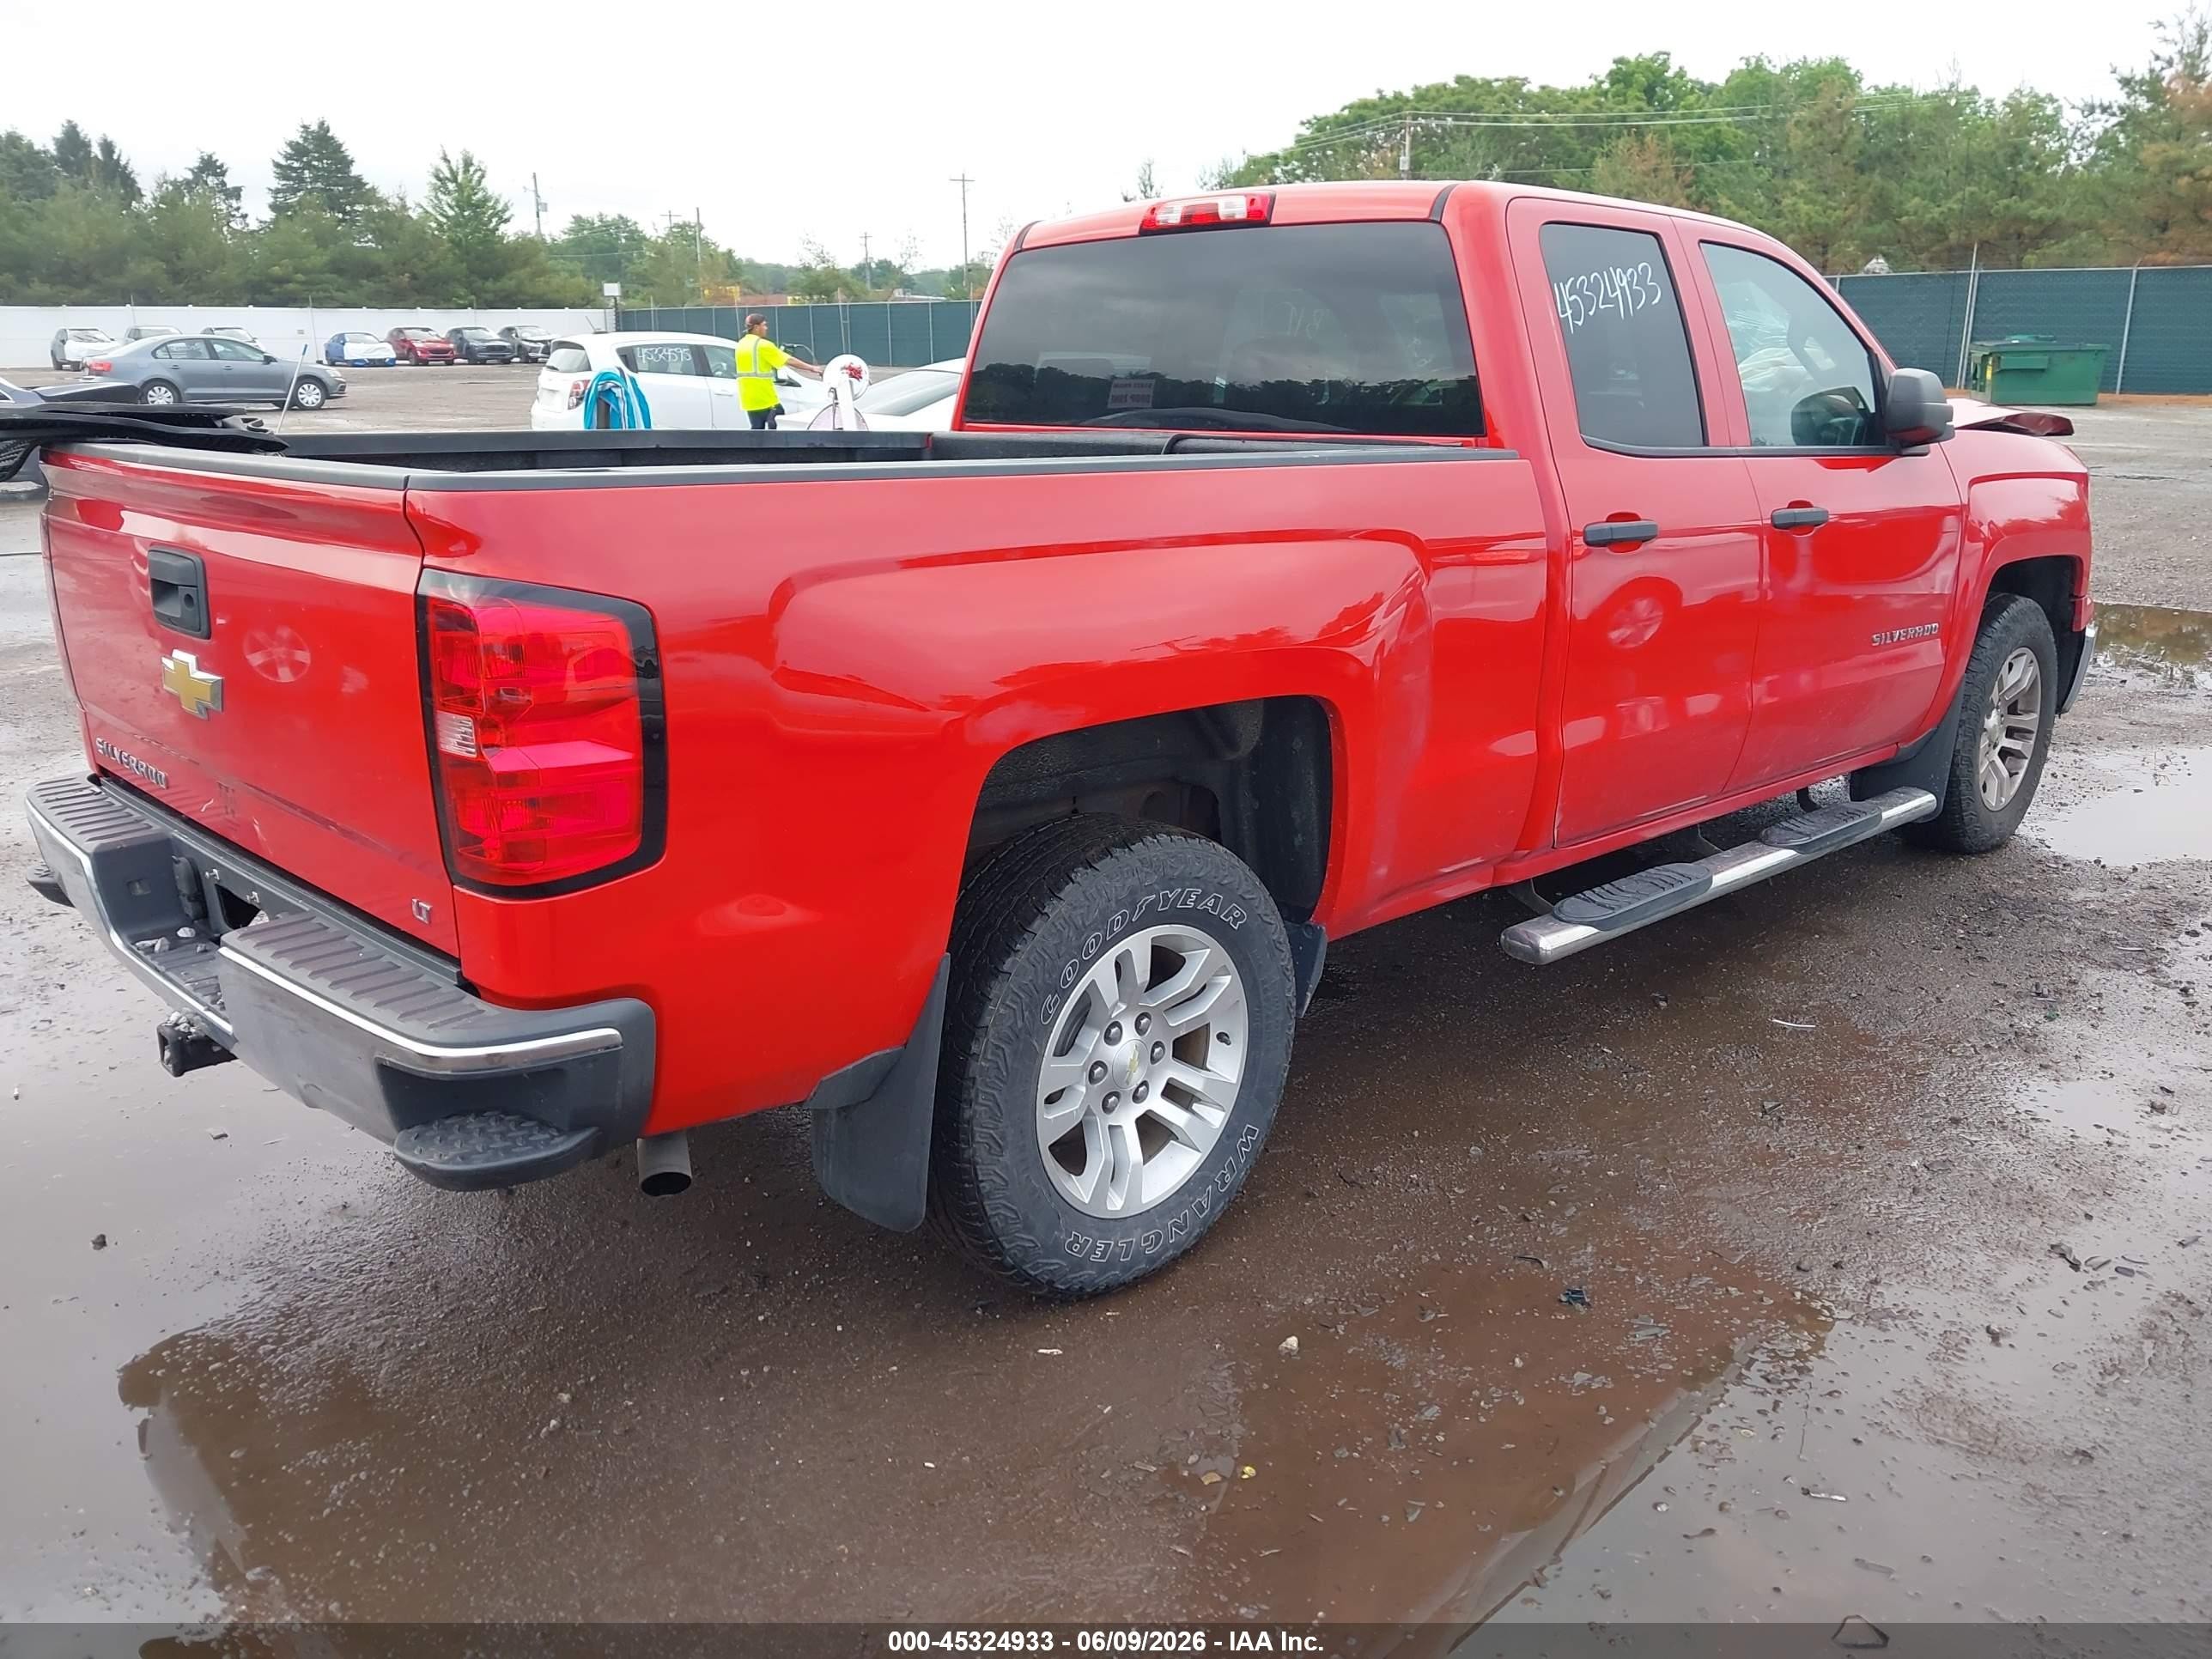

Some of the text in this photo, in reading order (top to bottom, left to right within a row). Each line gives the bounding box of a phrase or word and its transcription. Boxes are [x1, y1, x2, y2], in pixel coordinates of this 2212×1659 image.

[1553, 262, 1662, 334] 45324933
[1871, 623, 1939, 647] SILVERADO
[95, 737, 167, 789] SILVERADO
[411, 898, 433, 925] LT
[1040, 888, 1247, 1024] GOODYEAR
[1065, 1124, 1259, 1263] WRANGLER
